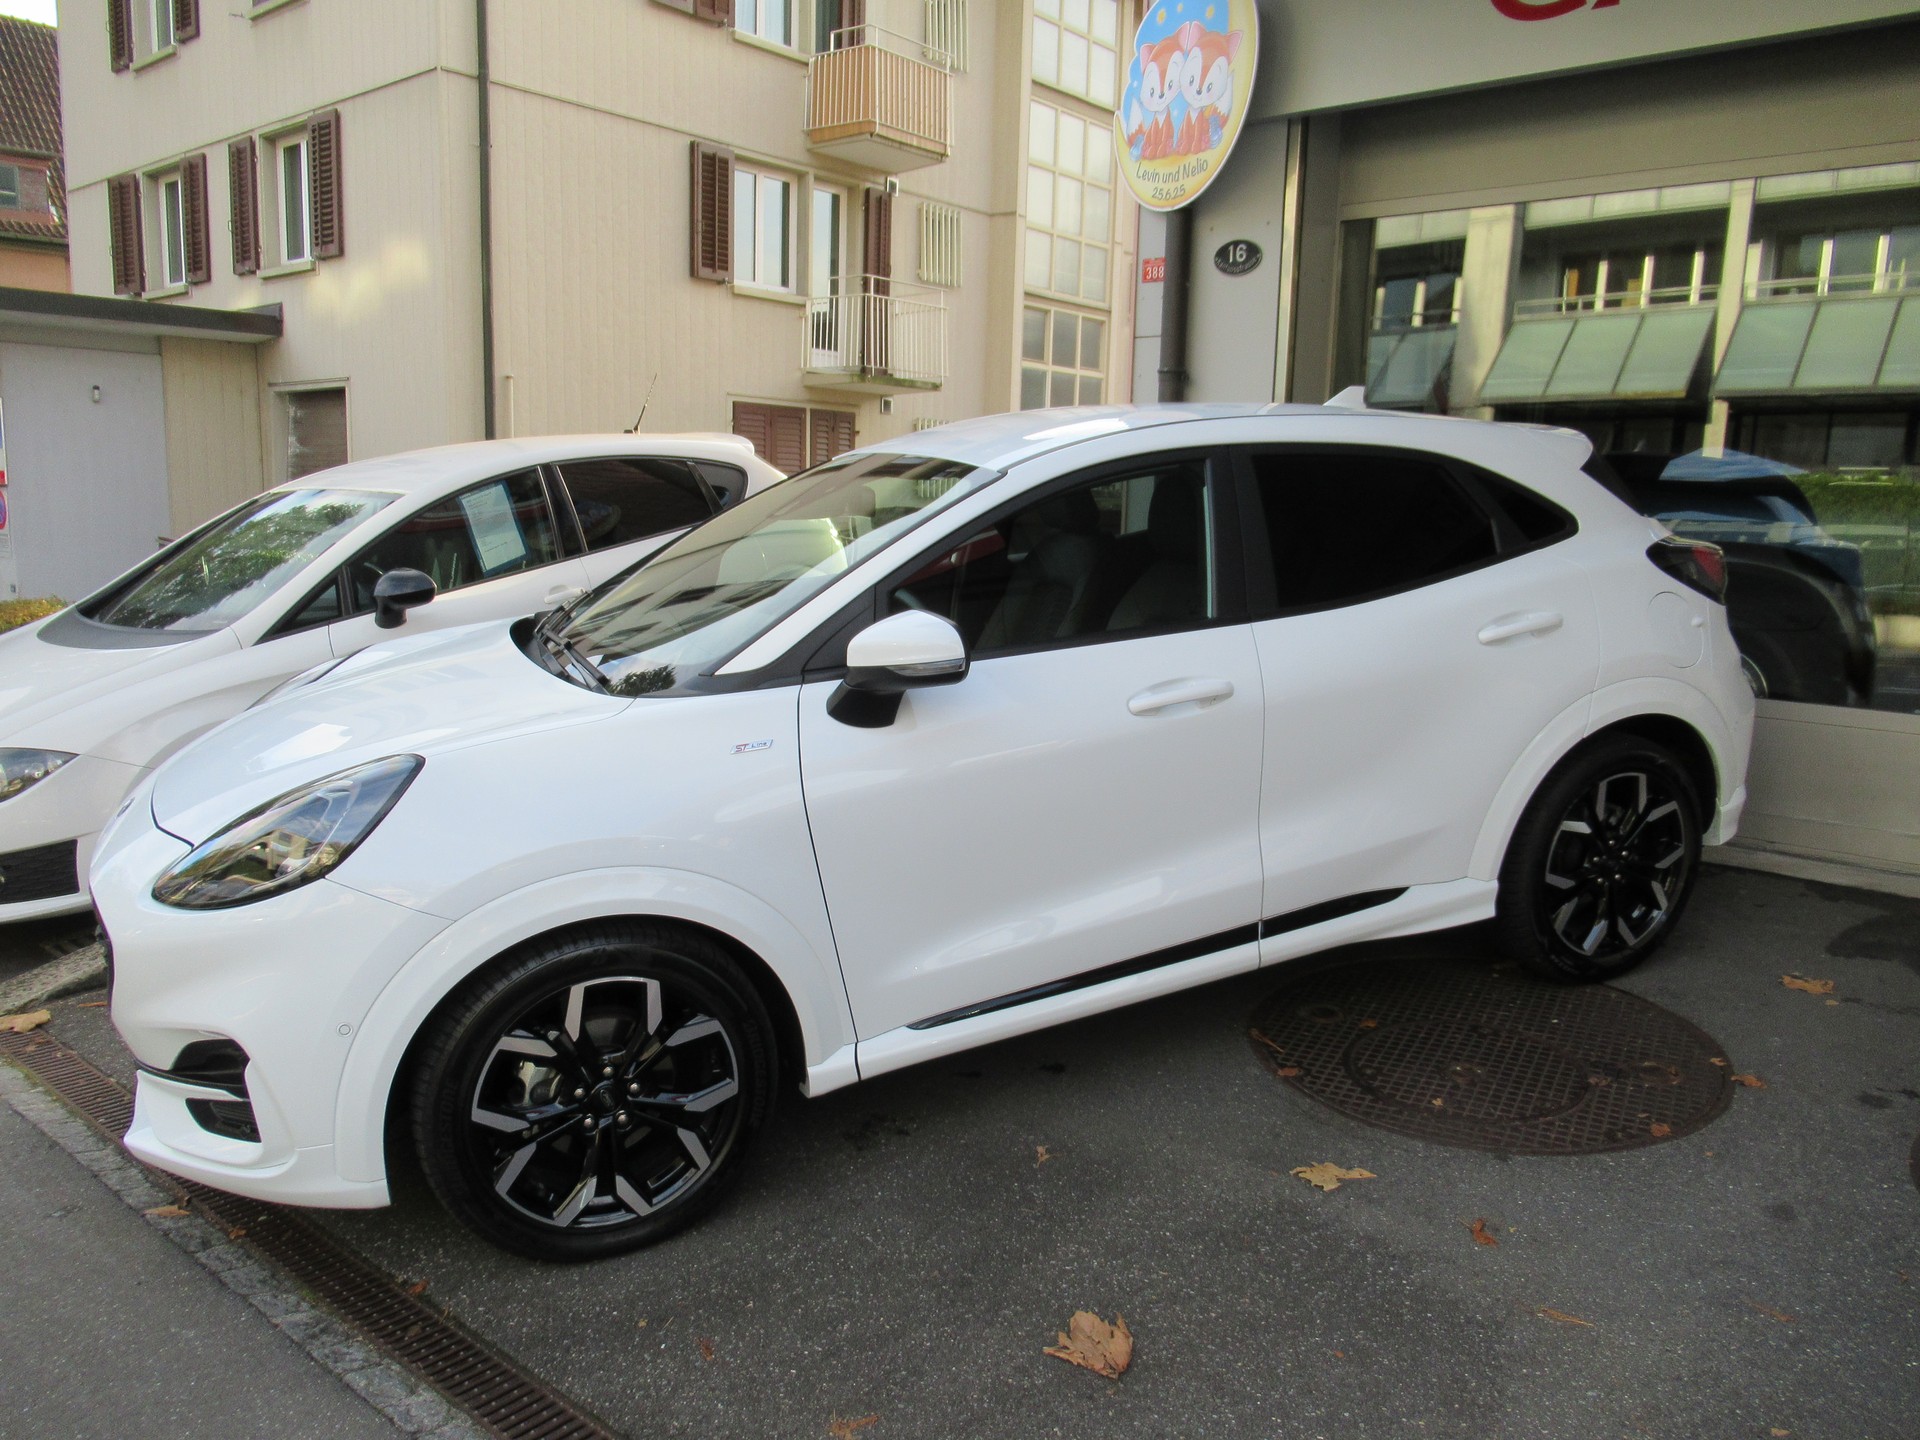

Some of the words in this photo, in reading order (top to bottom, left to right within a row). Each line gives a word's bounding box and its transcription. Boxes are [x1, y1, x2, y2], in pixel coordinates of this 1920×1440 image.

[1136, 162, 1160, 183] Levin
[1162, 166, 1181, 183] und
[1182, 158, 1209, 180] Nelio
[1151, 184, 1186, 201] 25.6.25
[1228, 243, 1247, 263] 16
[1146, 265, 1164, 279] 388
[735, 743, 749, 752] ST
